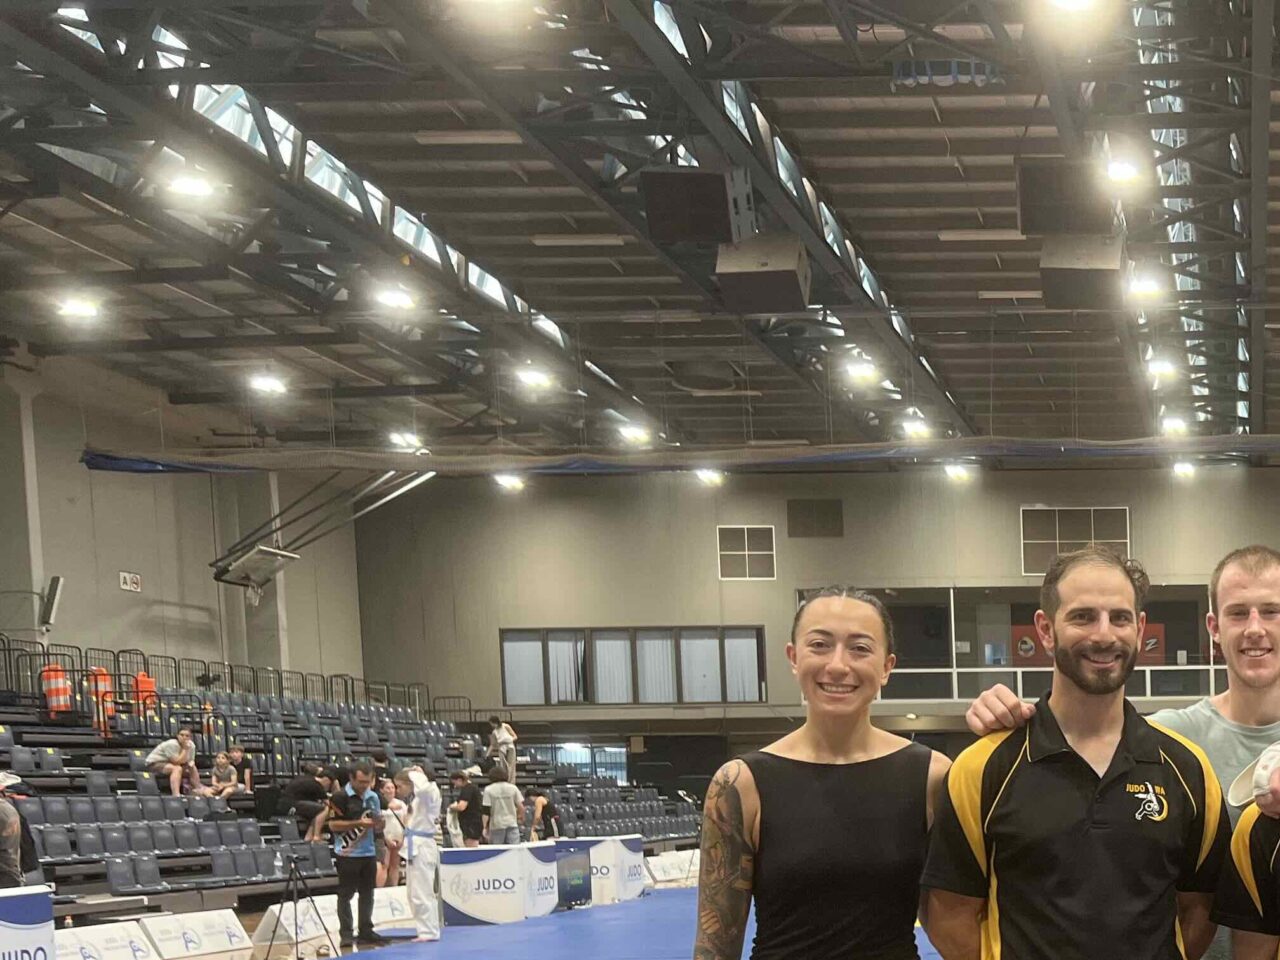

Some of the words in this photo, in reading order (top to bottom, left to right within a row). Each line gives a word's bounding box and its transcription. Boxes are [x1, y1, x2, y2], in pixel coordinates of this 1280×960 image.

[122, 575, 128, 586] A
[1126, 784, 1146, 793] JUDO
[591, 865, 610, 876] DO
[475, 878, 516, 891] JUDO
[537, 876, 554, 892] JUDO
